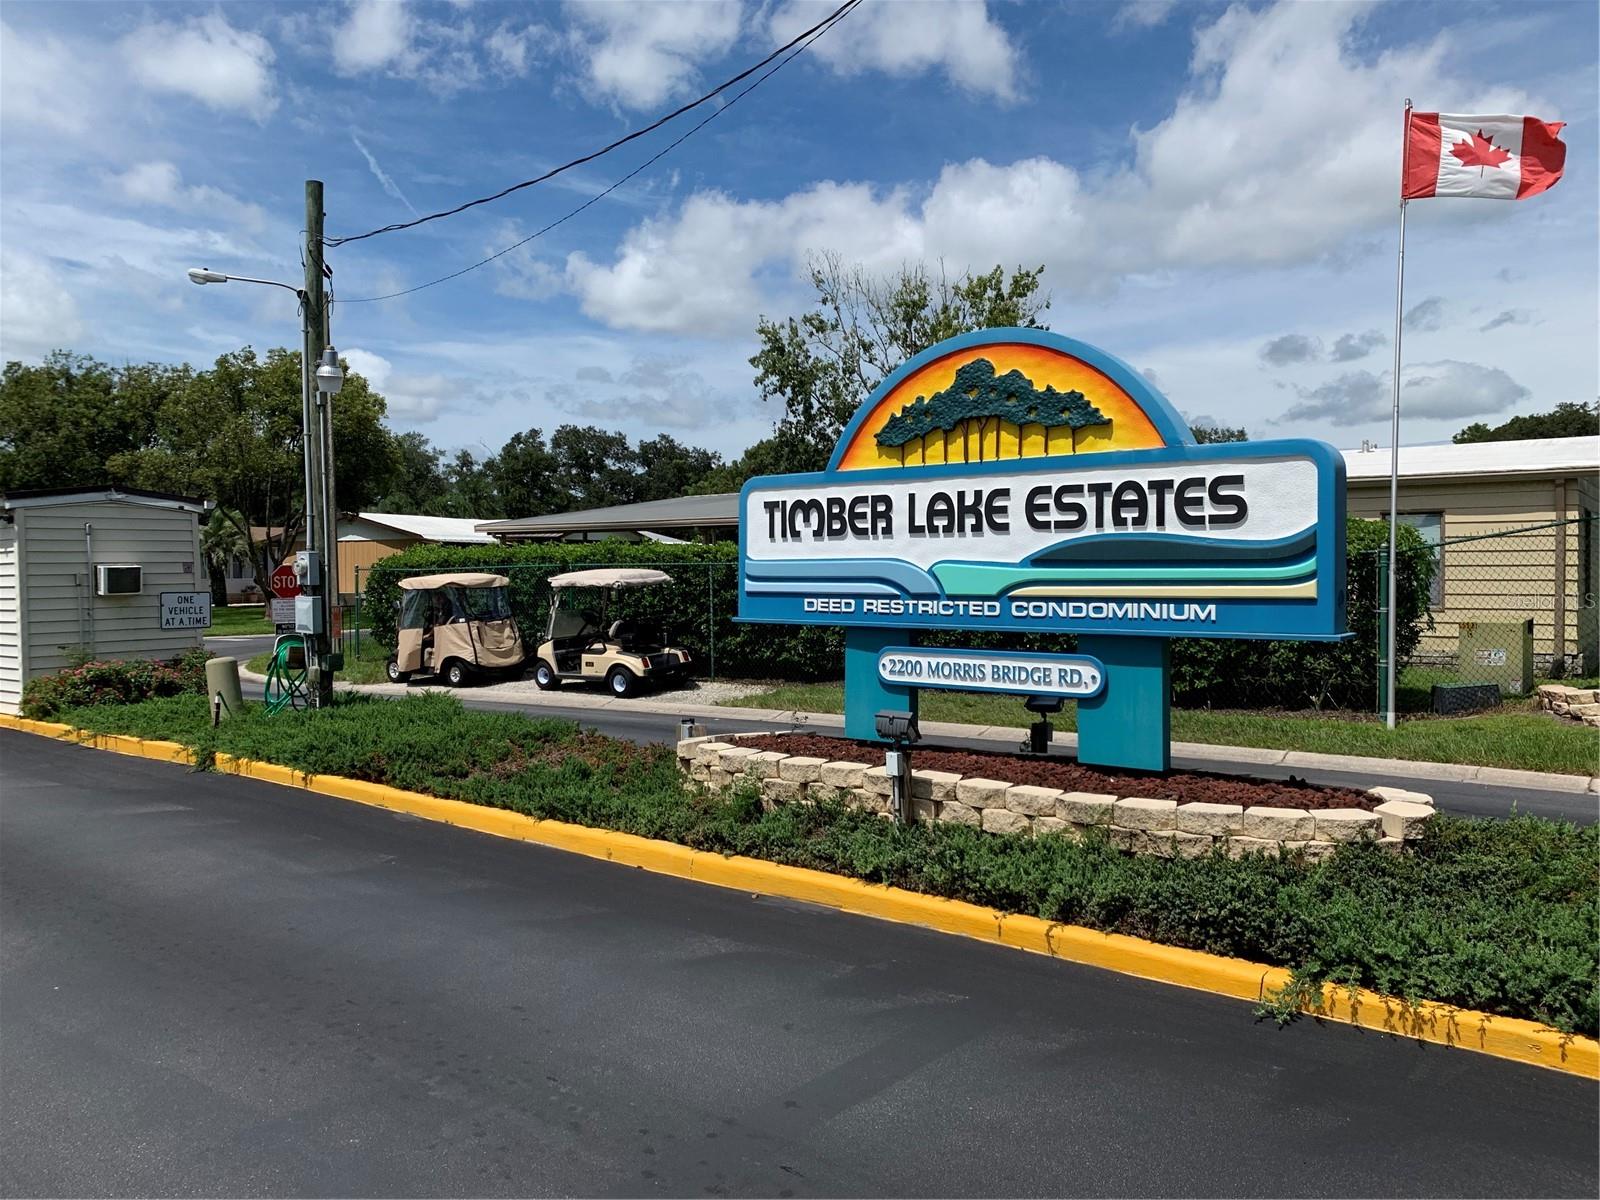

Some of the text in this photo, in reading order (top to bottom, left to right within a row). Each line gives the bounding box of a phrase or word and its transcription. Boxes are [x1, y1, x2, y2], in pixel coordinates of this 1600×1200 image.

[763, 474, 1248, 540] TIMBER LAKE ESTATES
[273, 575, 298, 589] STO
[177, 595, 195, 604] ONE
[168, 606, 204, 616] VEHICLE
[803, 598, 1217, 621] DEED RESTRICTED CONDOMINIUM
[165, 617, 175, 626] AT
[188, 616, 208, 626] TIME
[888, 658, 923, 677] 2200
[927, 660, 986, 680] MORRIS
[991, 665, 1052, 684] BRIDGE
